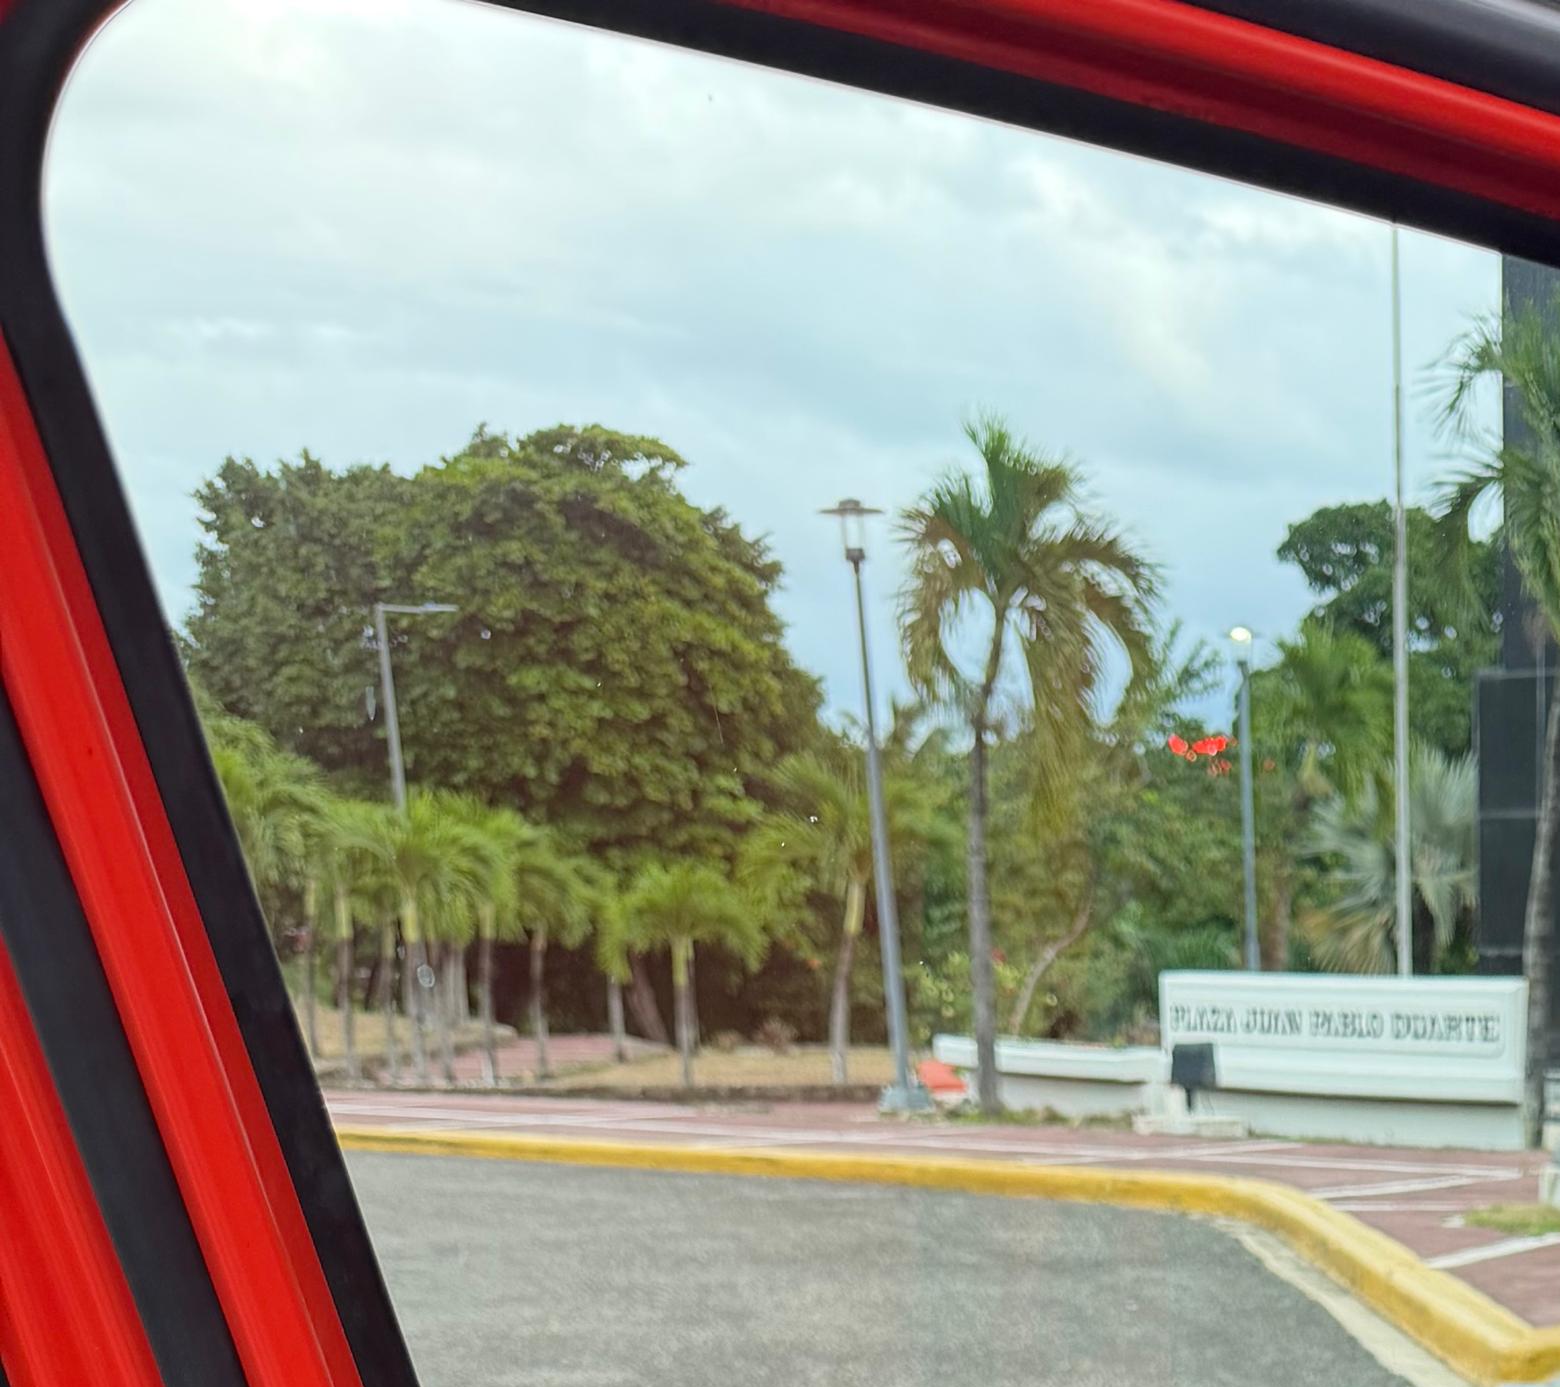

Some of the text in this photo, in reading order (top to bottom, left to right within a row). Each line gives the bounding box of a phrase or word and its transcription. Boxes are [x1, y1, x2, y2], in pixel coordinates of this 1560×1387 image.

[1169, 1003, 1500, 1043] PLAZA JUAN PABLO DUARTE
